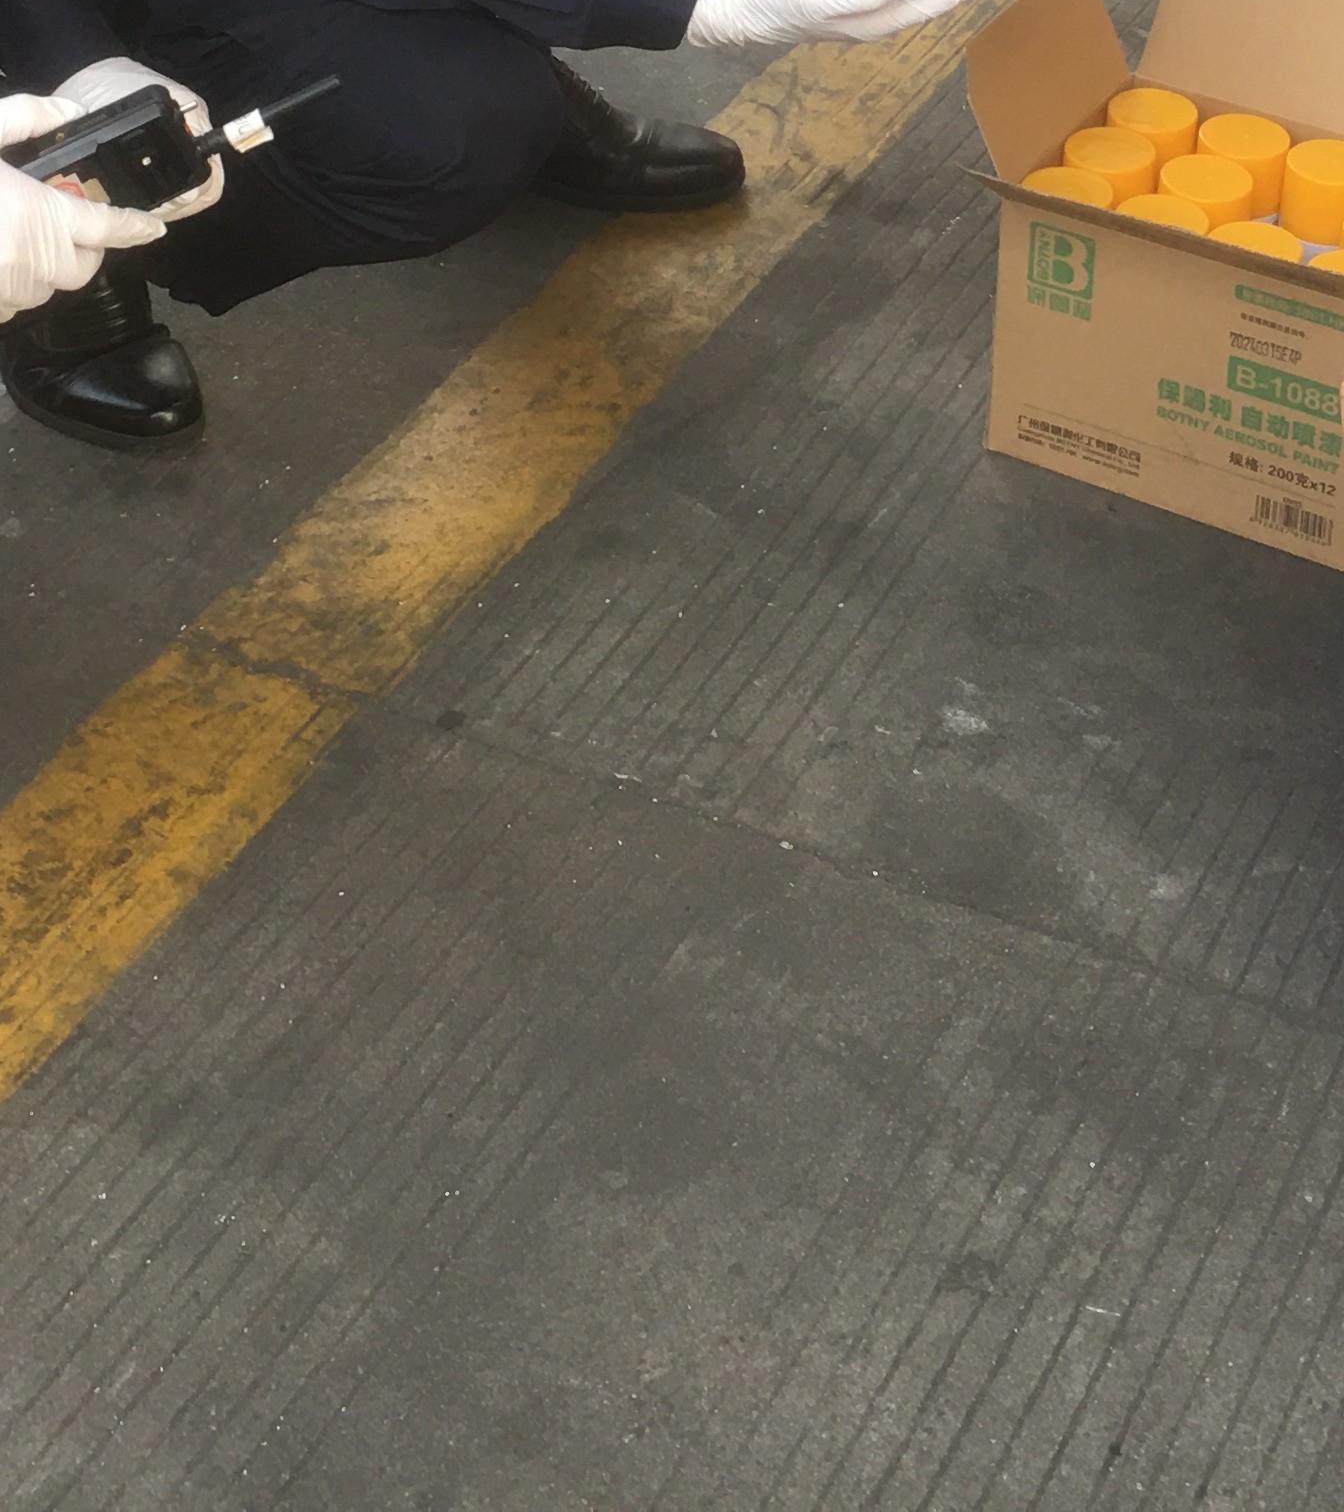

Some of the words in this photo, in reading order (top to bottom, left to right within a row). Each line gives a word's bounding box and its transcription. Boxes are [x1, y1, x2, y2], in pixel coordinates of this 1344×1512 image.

[1235, 364, 1338, 417] B-1088
[1156, 405, 1208, 432] BOTNY
[1214, 423, 1287, 457] AEROSOL
[1293, 449, 1339, 475] PAINT
